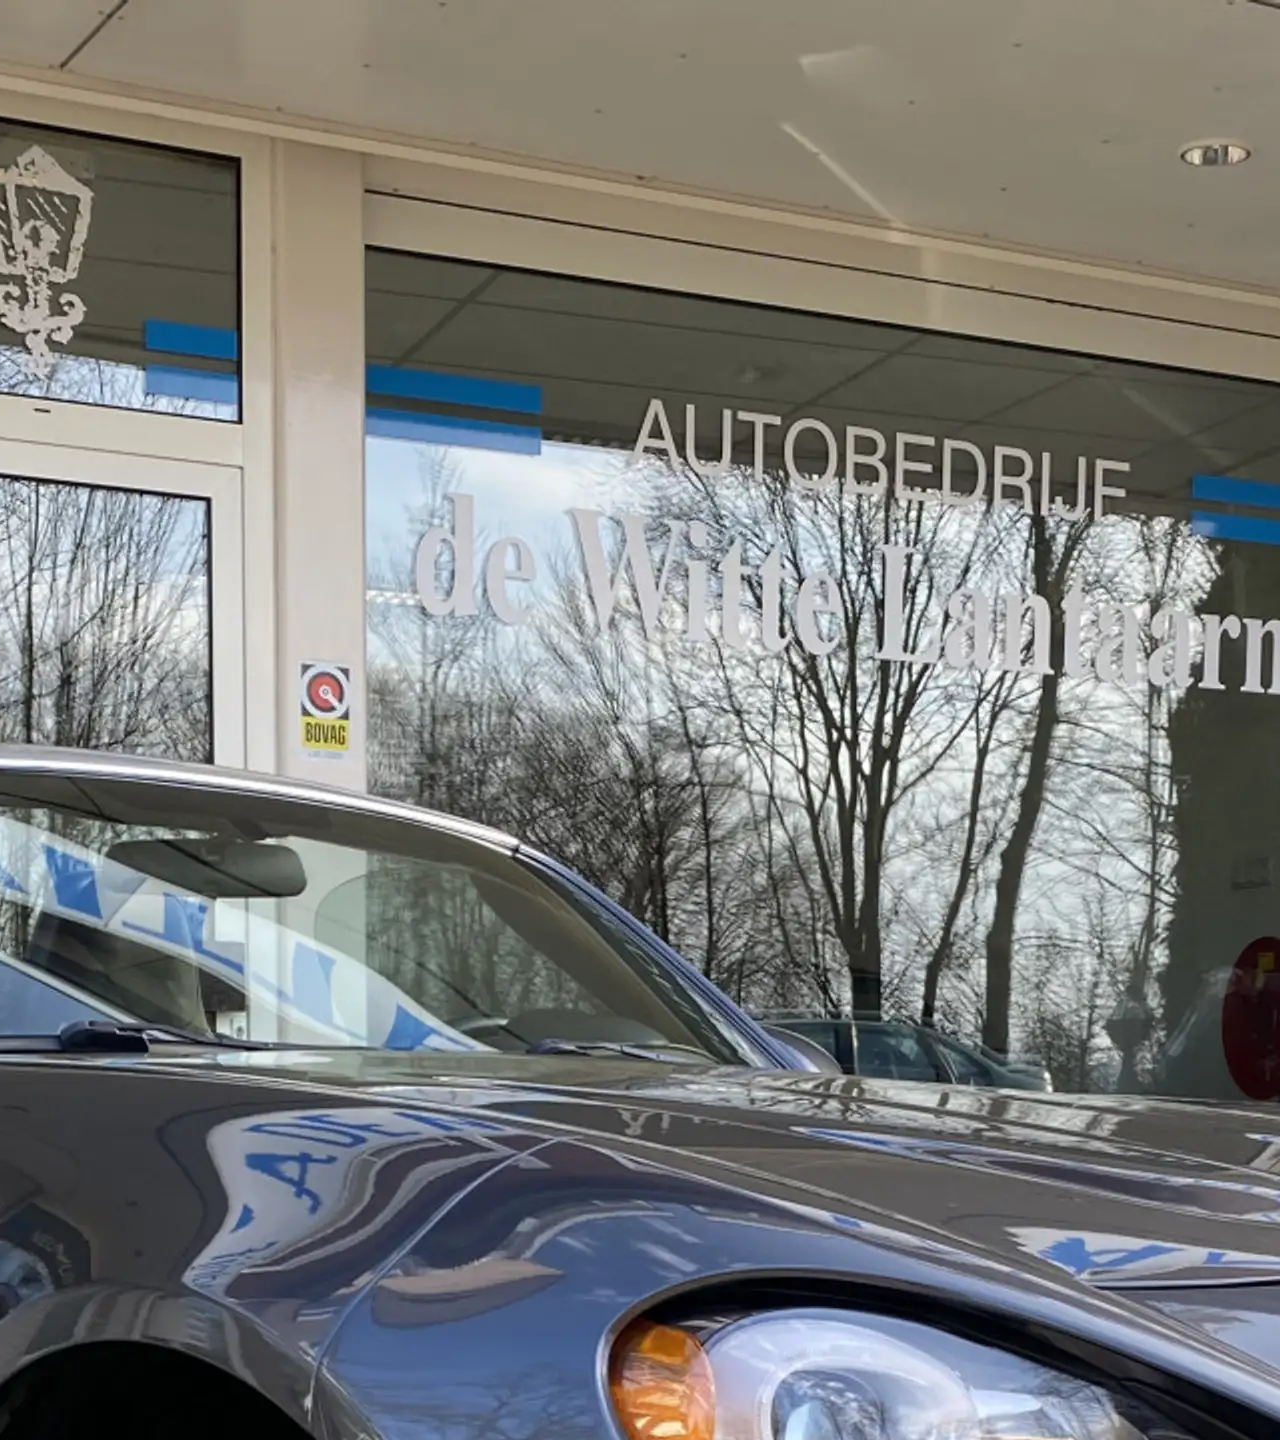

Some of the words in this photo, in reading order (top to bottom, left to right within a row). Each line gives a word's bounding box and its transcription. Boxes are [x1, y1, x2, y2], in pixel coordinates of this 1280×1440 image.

[633, 398, 1132, 522] AUTOBEDRIJF
[415, 493, 538, 626] de
[564, 507, 845, 656] Witte
[304, 721, 347, 746] BOVAG
